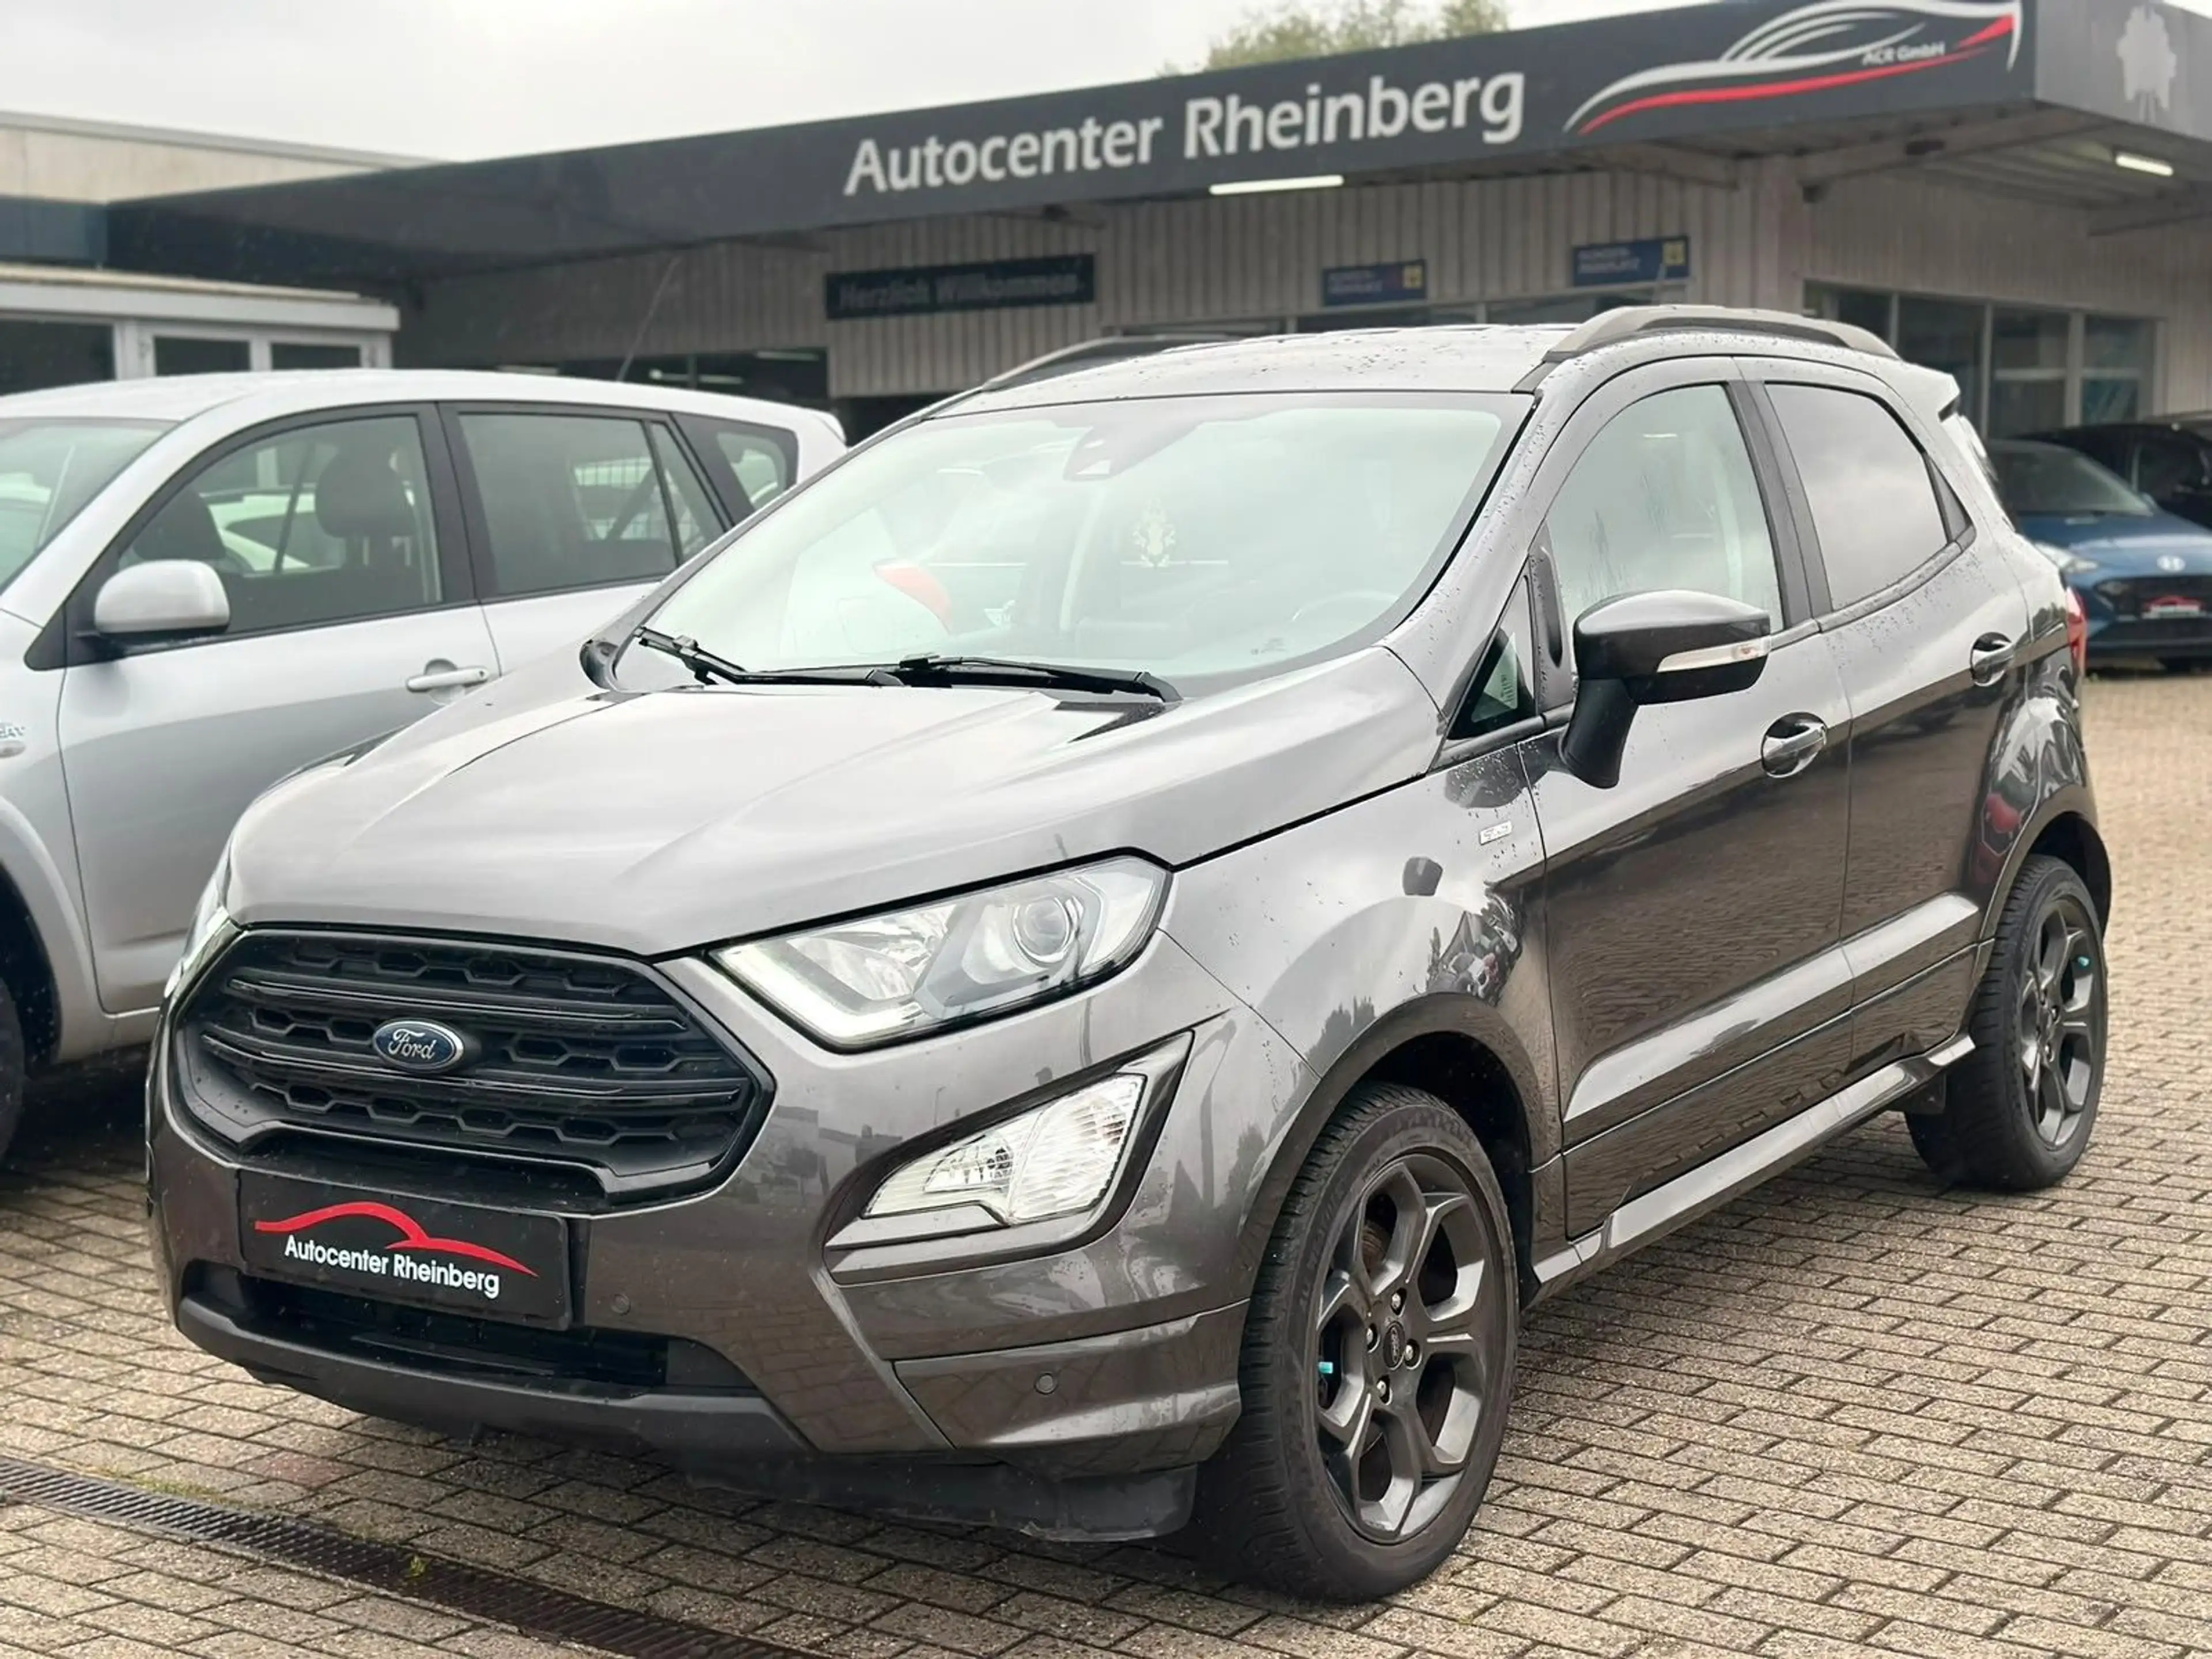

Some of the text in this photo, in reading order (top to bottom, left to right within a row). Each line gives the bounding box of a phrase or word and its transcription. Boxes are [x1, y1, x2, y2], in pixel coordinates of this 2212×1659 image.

[1897, 40, 1946, 62] GmbH
[843, 72, 1525, 196] Autocenter Rheinberg
[388, 1028, 438, 1060] Ford
[284, 1234, 500, 1300] Autocenter Rheinberg
